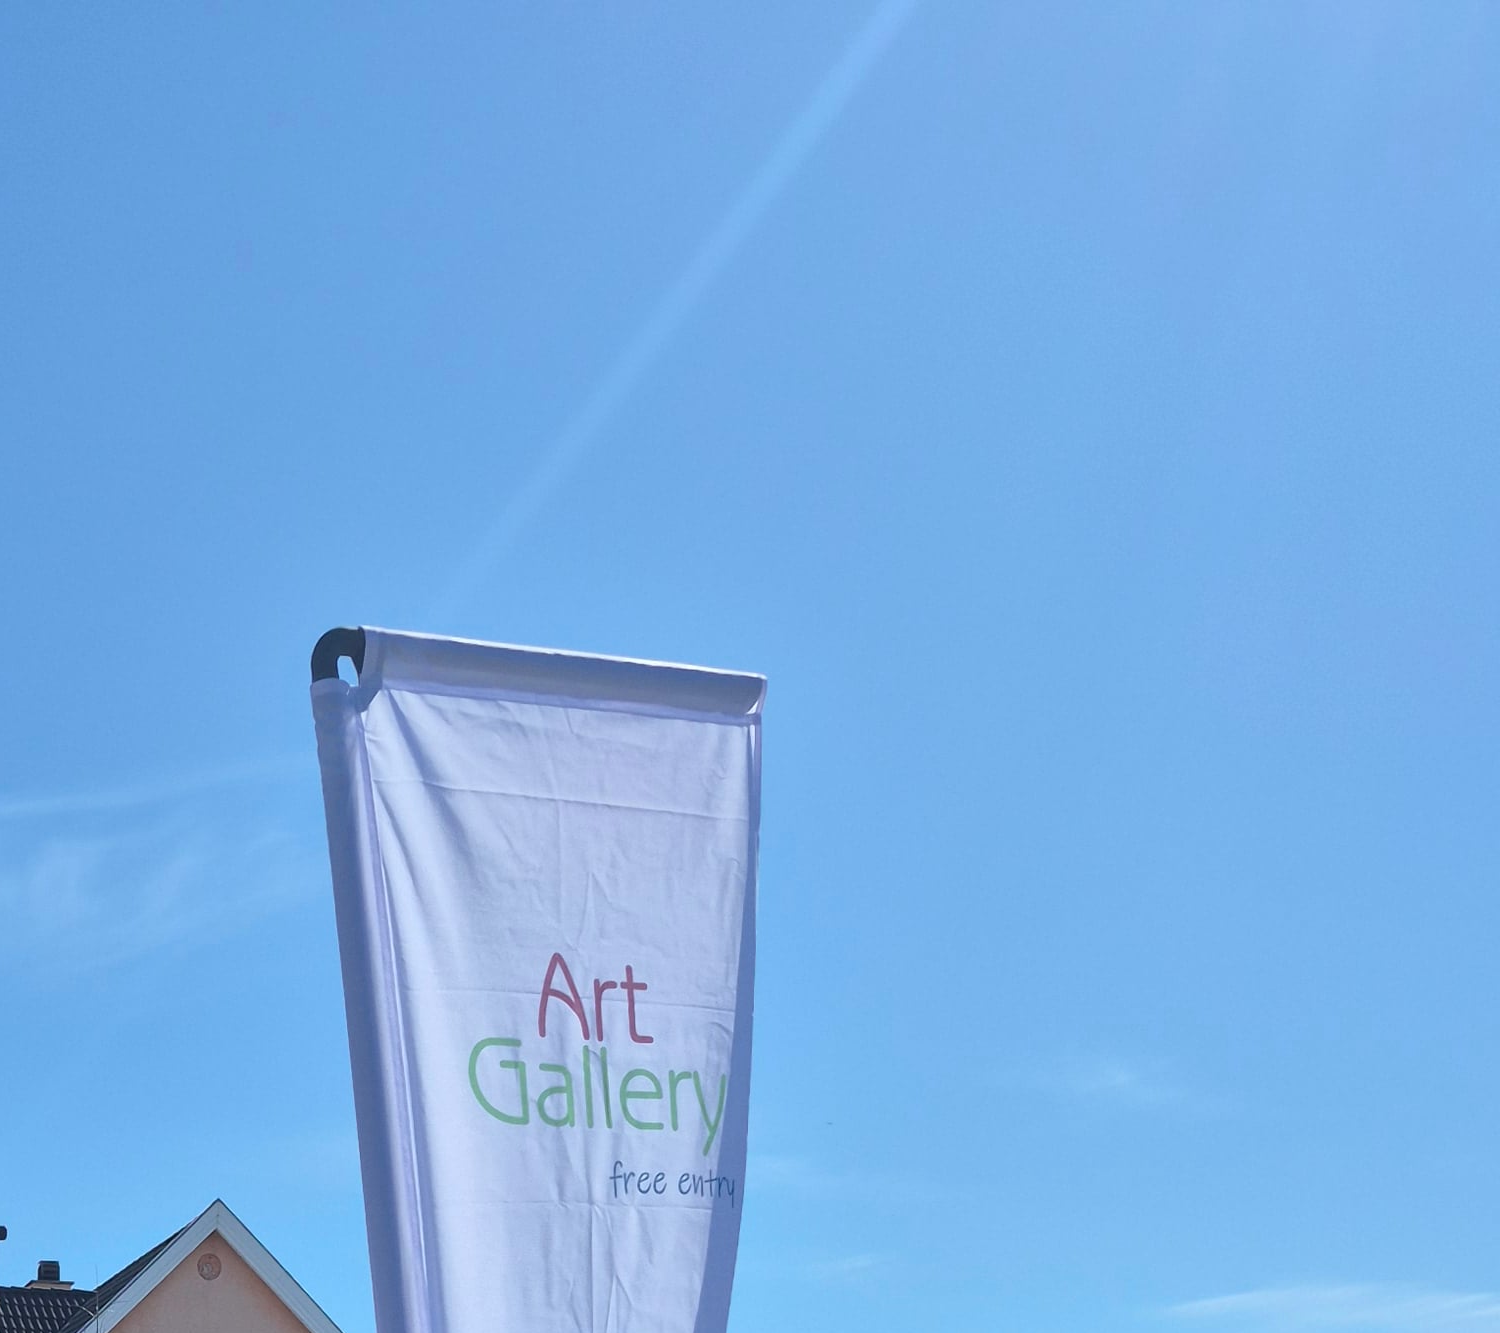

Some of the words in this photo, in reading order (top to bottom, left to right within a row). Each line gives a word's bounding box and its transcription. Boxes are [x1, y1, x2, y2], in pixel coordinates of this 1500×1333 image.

[538, 952, 654, 1044] Art
[467, 1037, 727, 1157] Gallery
[608, 1160, 668, 1199] free
[677, 1168, 735, 1209] entry
